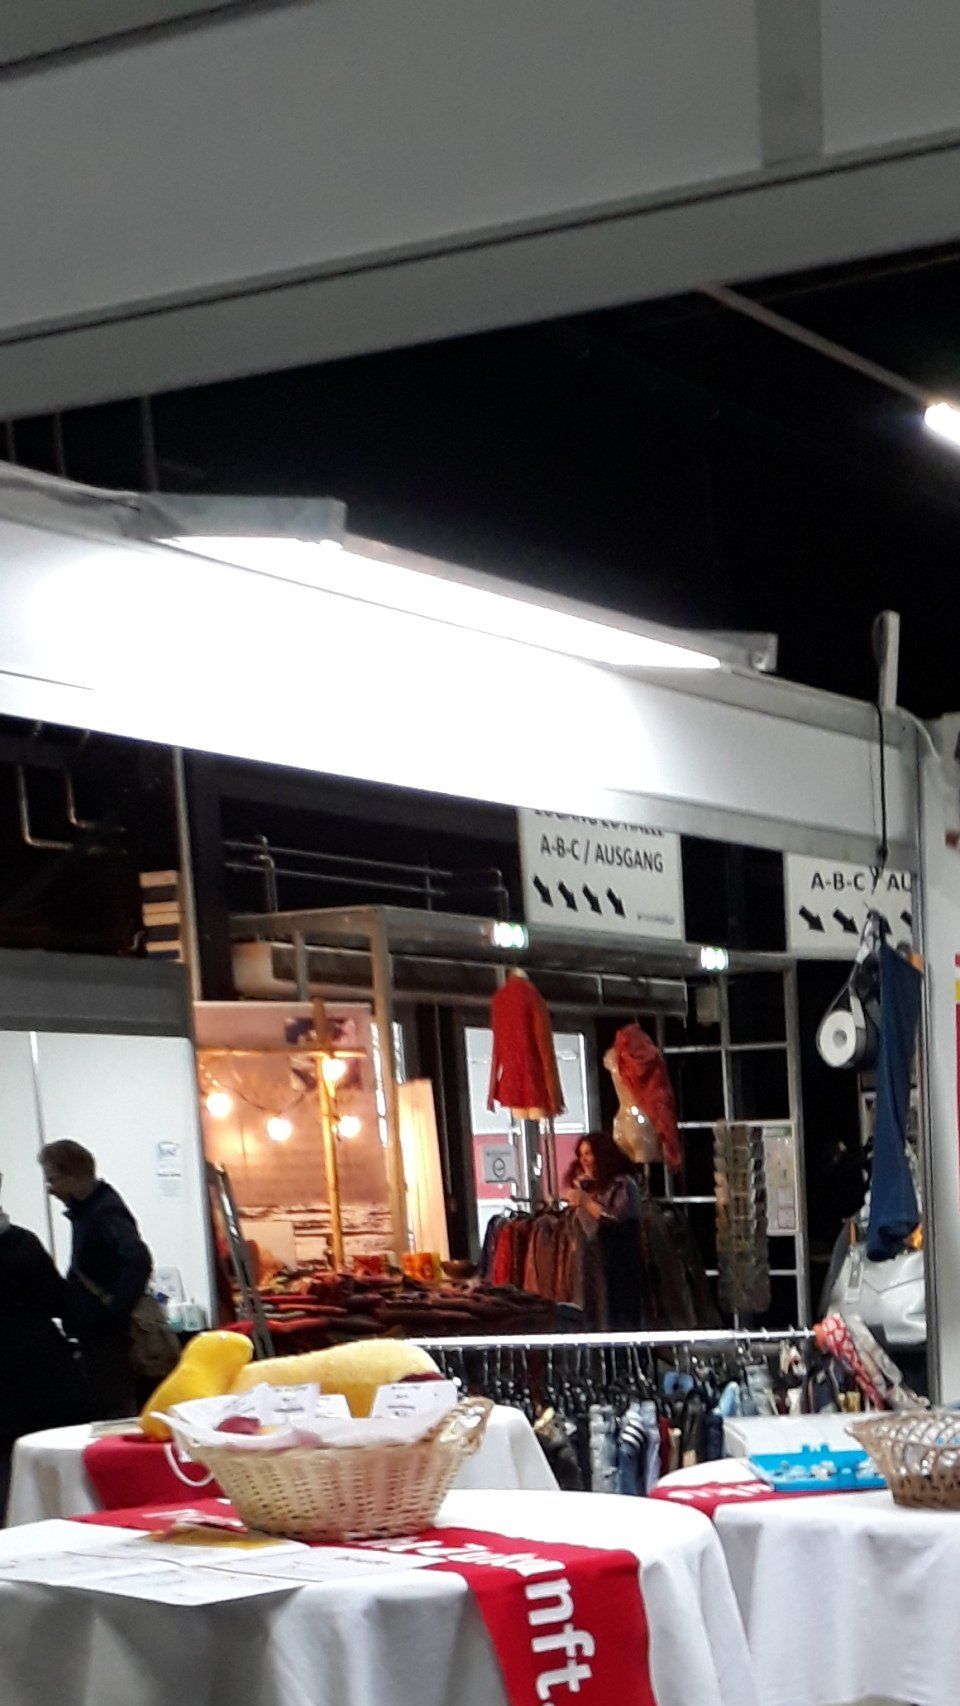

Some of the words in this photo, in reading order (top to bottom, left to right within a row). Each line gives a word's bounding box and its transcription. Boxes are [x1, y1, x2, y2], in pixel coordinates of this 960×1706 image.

[540, 833, 580, 861] A-B-C
[595, 842, 664, 874] AUSGANG
[811, 871, 865, 892] A-B-C
